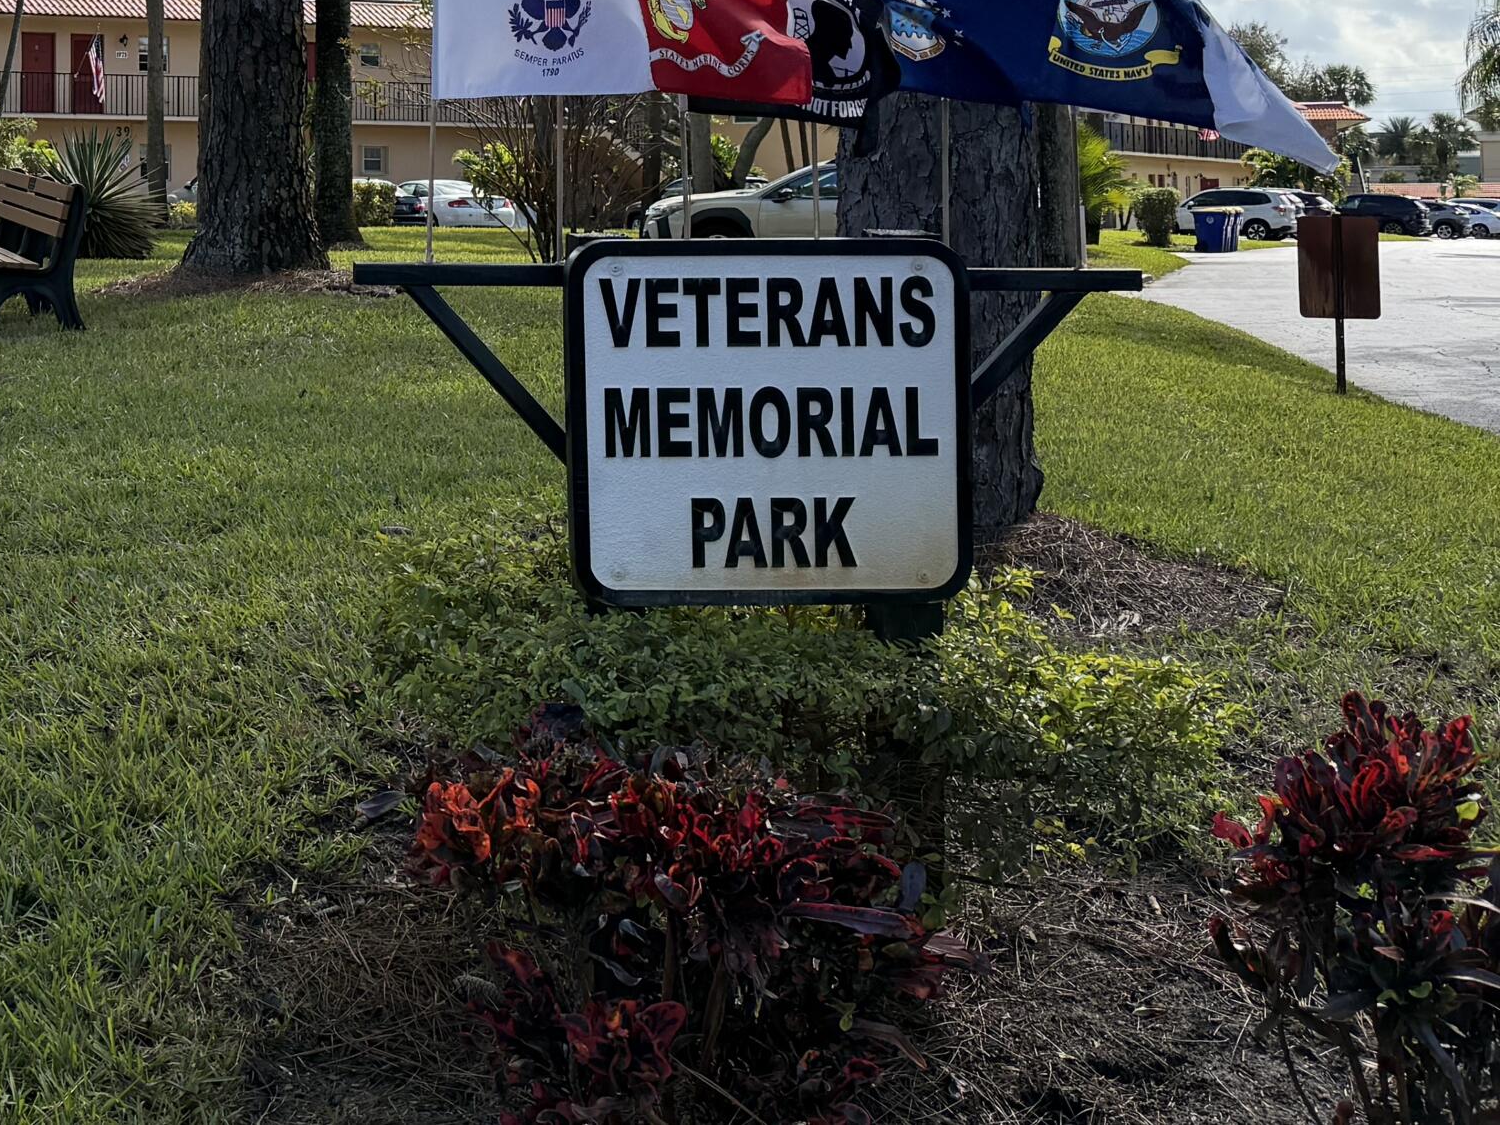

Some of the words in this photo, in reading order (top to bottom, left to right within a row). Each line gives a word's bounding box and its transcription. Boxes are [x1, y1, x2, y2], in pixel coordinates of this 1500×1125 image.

[514, 49, 548, 66] SEMPER
[552, 47, 584, 66] PARATUS
[727, 49, 755, 76] CORPS
[1052, 54, 1086, 73] UNITED
[1089, 67, 1121, 79] STATES
[1123, 67, 1149, 79] NAVY
[542, 67, 560, 77] 1790
[599, 275, 936, 348] VETERANS
[604, 385, 939, 459] MEMORIAL
[690, 496, 858, 569] PARK
